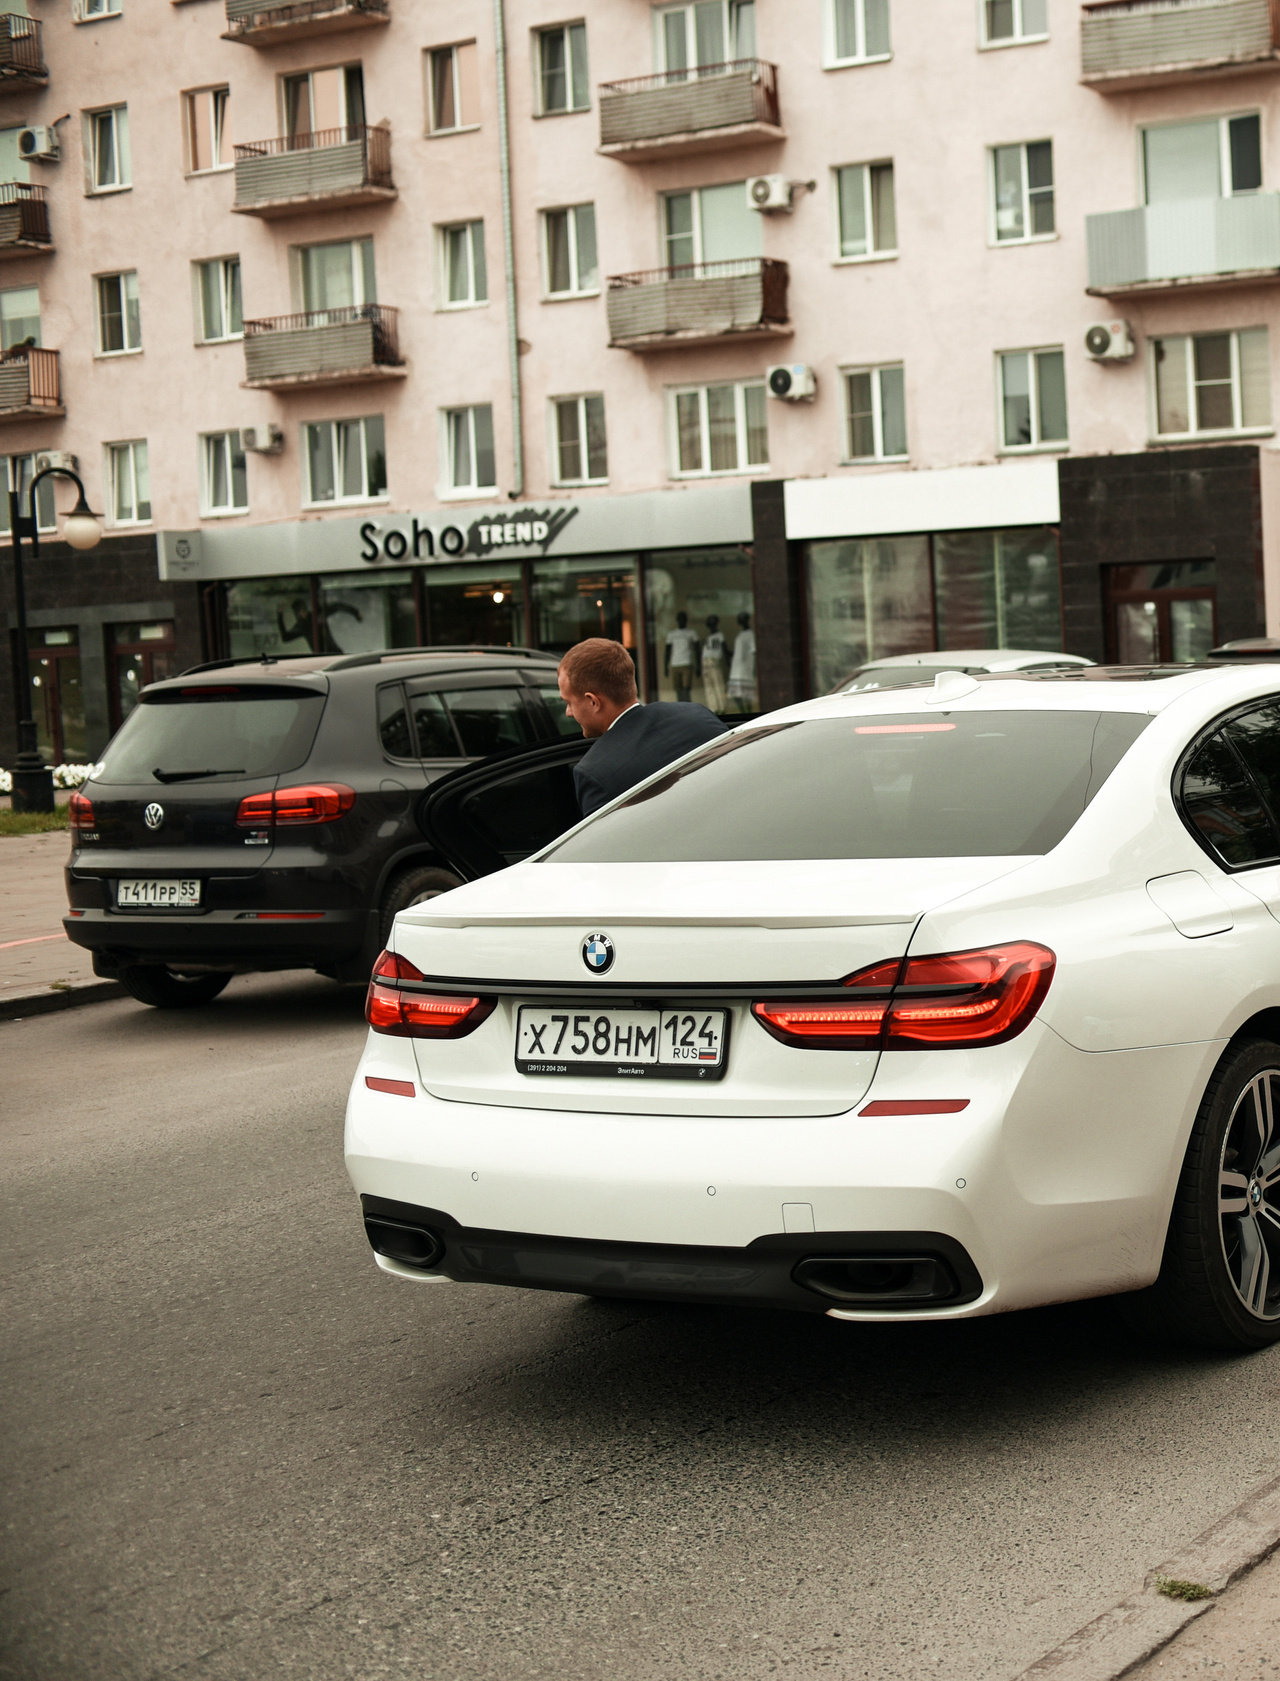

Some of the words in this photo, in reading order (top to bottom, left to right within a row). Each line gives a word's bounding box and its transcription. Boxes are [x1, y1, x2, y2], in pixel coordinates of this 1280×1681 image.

[361, 518, 464, 562] Soho
[478, 520, 549, 545] TREND
[181, 881, 196, 896] 55
[584, 934, 613, 948] BMW
[664, 1015, 714, 1047] 124
[672, 1047, 698, 1059] RUS
[527, 1064, 542, 1072] (391)
[617, 1066, 645, 1075] ЭлитАвто
